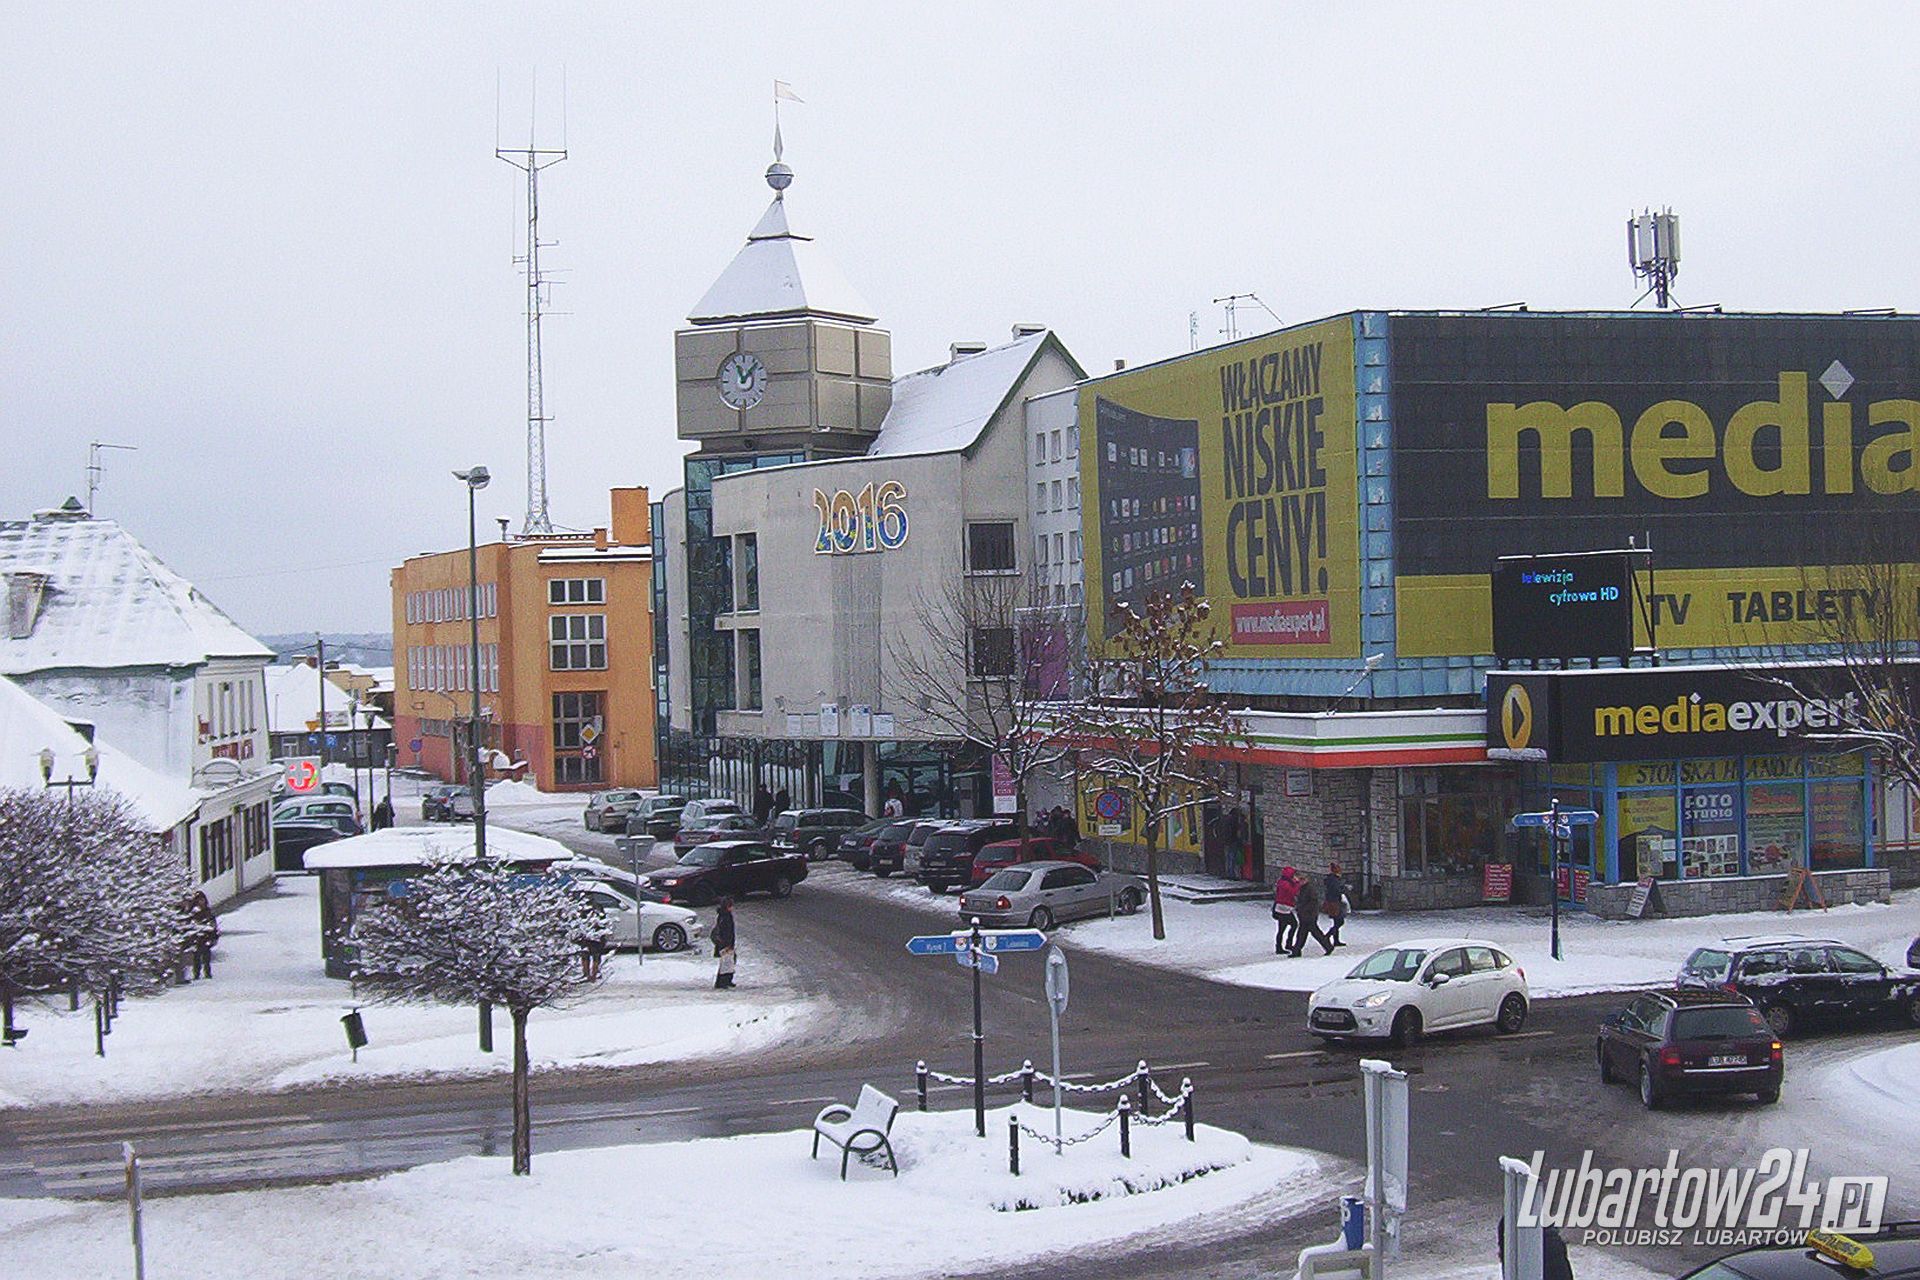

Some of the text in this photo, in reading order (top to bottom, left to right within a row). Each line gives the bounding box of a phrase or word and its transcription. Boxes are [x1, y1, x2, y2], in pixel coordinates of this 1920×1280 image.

[1220, 342, 1323, 413] WŁĄCZAMY
[1222, 397, 1328, 499] NISKIE
[1486, 359, 1920, 499] media
[812, 480, 910, 556] 2016
[1226, 492, 1328, 598] CENY!
[1549, 586, 1620, 606] cyfrowa HD
[1646, 593, 1692, 626] TV
[1727, 588, 1880, 624] TABLETY
[1595, 691, 1860, 738] mediaexpert
[1684, 793, 1733, 809] FOTO
[1684, 808, 1734, 821] STUDIO
